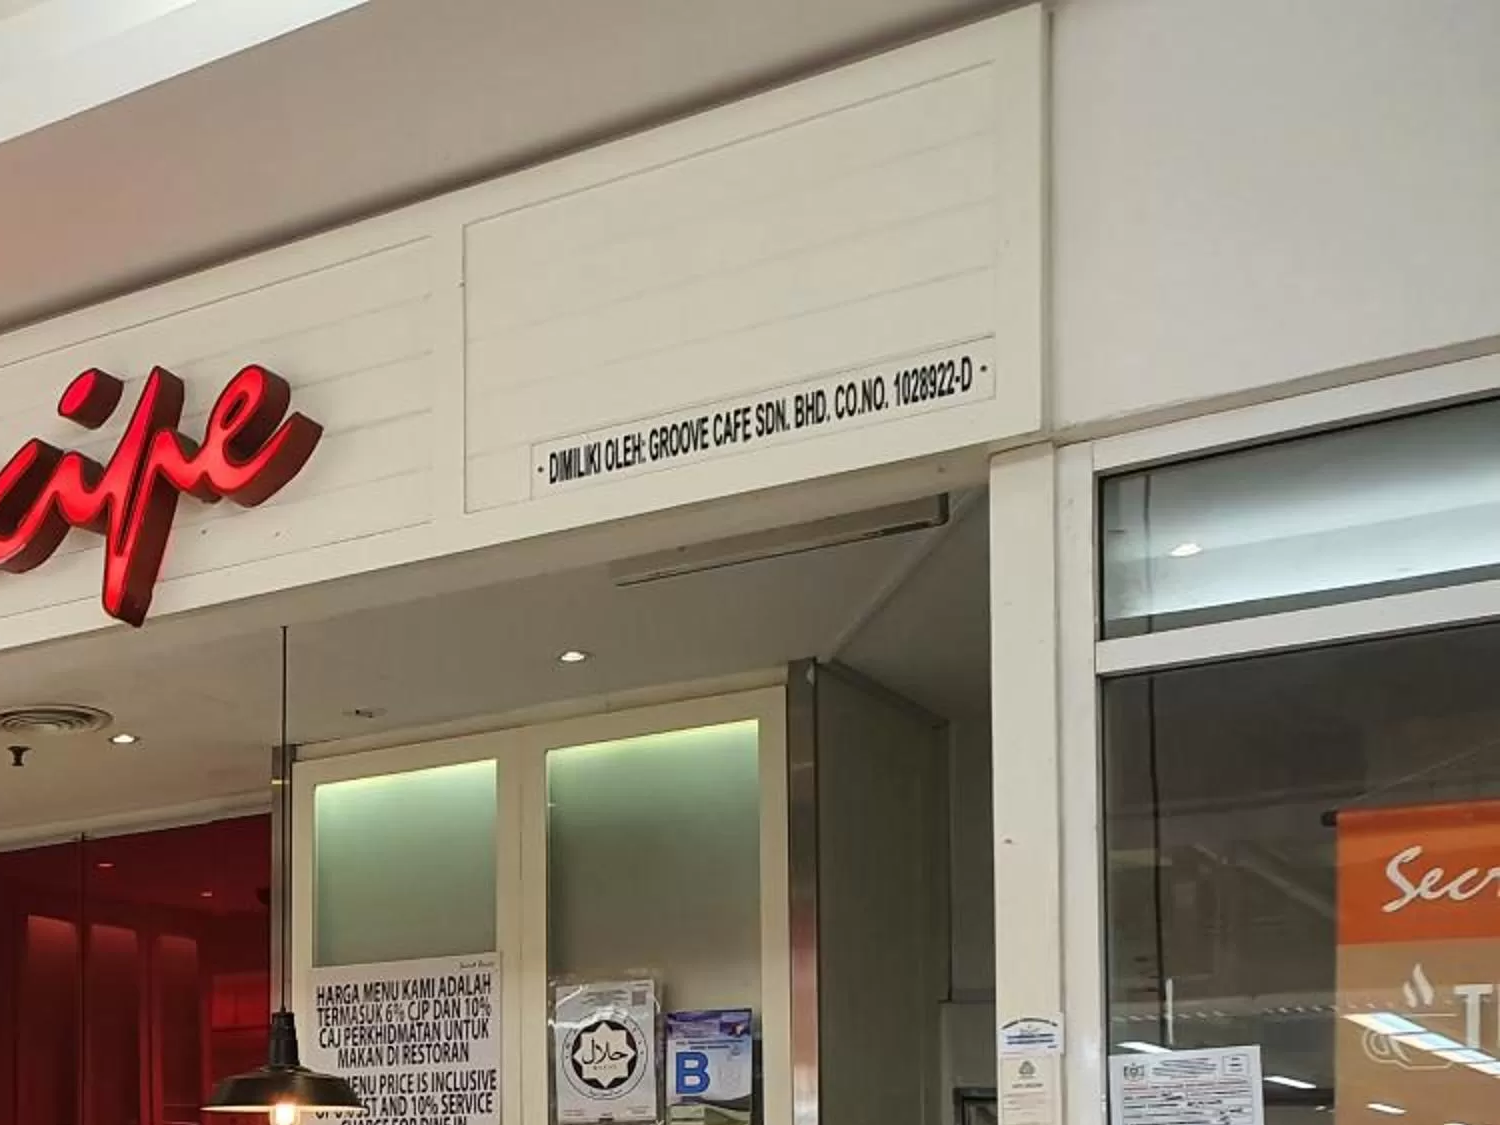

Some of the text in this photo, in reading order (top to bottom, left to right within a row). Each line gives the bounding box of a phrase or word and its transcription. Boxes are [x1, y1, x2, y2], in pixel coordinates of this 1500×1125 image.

[549, 356, 973, 484] DIMILIKI OLEH: GROOVE CAFE SDN. BHD. CO.NO. 1028922-D
[316, 973, 491, 1006] HARGA MENU KAMI ADALAH
[316, 1003, 383, 1027] TERMASUK
[385, 1002, 405, 1023] 6%
[433, 998, 461, 1020] DAN
[465, 996, 491, 1018] 10%
[319, 1018, 489, 1048] CAJ PERKHIDMATAN UNTUK
[338, 1042, 469, 1069] MAKAN DI RESTORAN
[347, 1068, 497, 1095] ENU PRICE IS INCLUSIVE
[675, 1051, 710, 1095] B
[381, 1096, 408, 1117] AND
[411, 1095, 439, 1116] 10%
[441, 1092, 493, 1115] SERVICE
